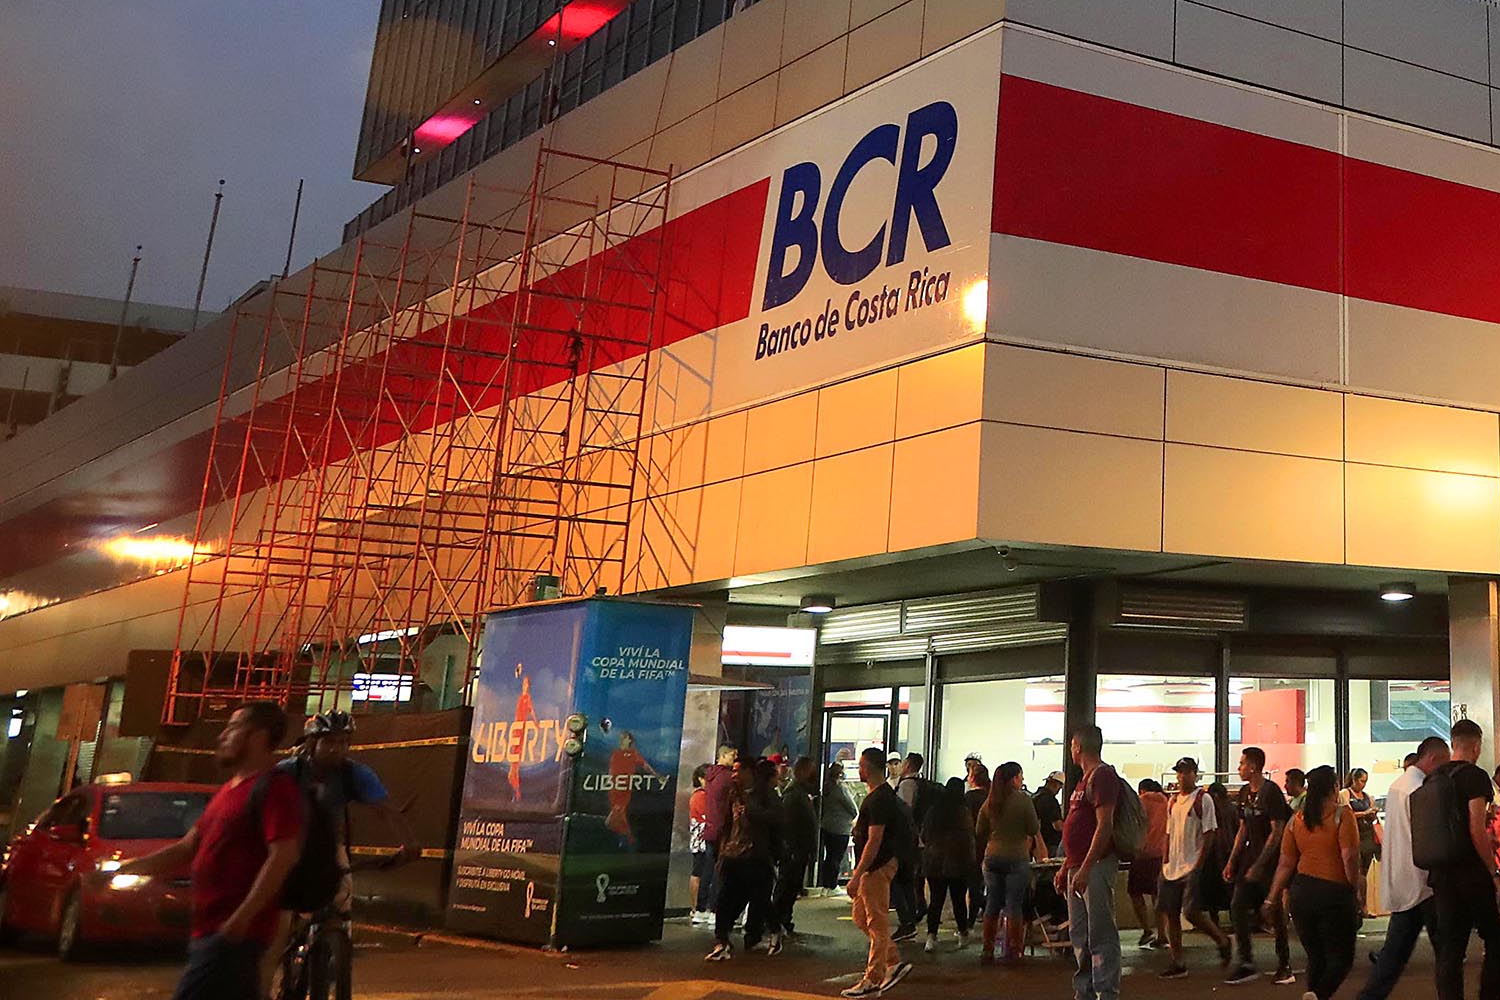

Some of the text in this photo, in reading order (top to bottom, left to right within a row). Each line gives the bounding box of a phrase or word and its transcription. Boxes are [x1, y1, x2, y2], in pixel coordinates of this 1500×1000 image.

[762, 101, 958, 312] BCR
[755, 266, 951, 361] Banco de Costa Rica
[619, 645, 660, 658] VIVÍ LA
[592, 657, 685, 670] COPA MUNDIAL
[600, 668, 617, 679] DE
[620, 669, 635, 680] LA
[472, 719, 570, 763] LIBERTY
[583, 774, 671, 791] LIBERTY
[476, 822, 485, 836] LA
[486, 821, 505, 837] COPA
[461, 836, 490, 852] MUNDIAL
[491, 837, 501, 852] DE
[501, 838, 510, 853] LA
